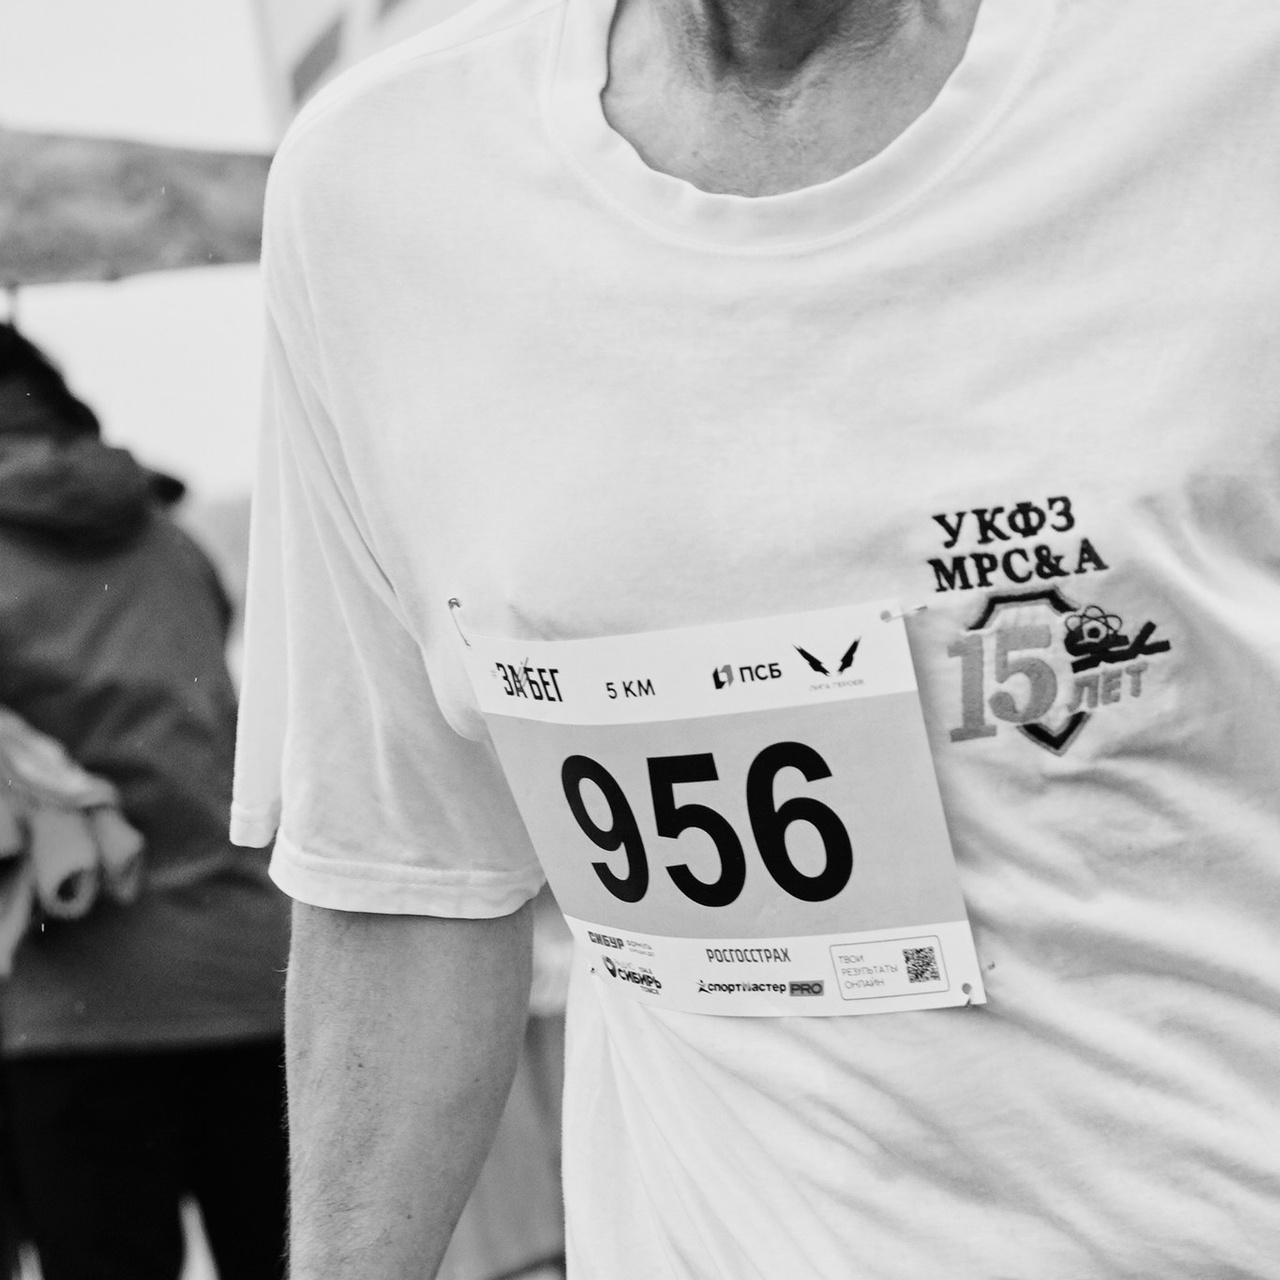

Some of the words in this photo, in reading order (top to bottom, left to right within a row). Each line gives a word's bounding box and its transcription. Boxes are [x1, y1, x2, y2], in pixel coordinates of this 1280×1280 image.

[932, 495, 1075, 549] УКФЗ
[739, 662, 783, 684] ПСБ
[947, 624, 1058, 742] 15
[1066, 661, 1149, 713] ЛЕТ
[606, 682, 618, 700] 5
[561, 741, 853, 908] 956
[587, 930, 625, 950] СИБУР
[705, 947, 792, 963] РОСГОССТРАХ
[617, 968, 662, 990] СИБИРЬ
[790, 982, 823, 995] PRO
